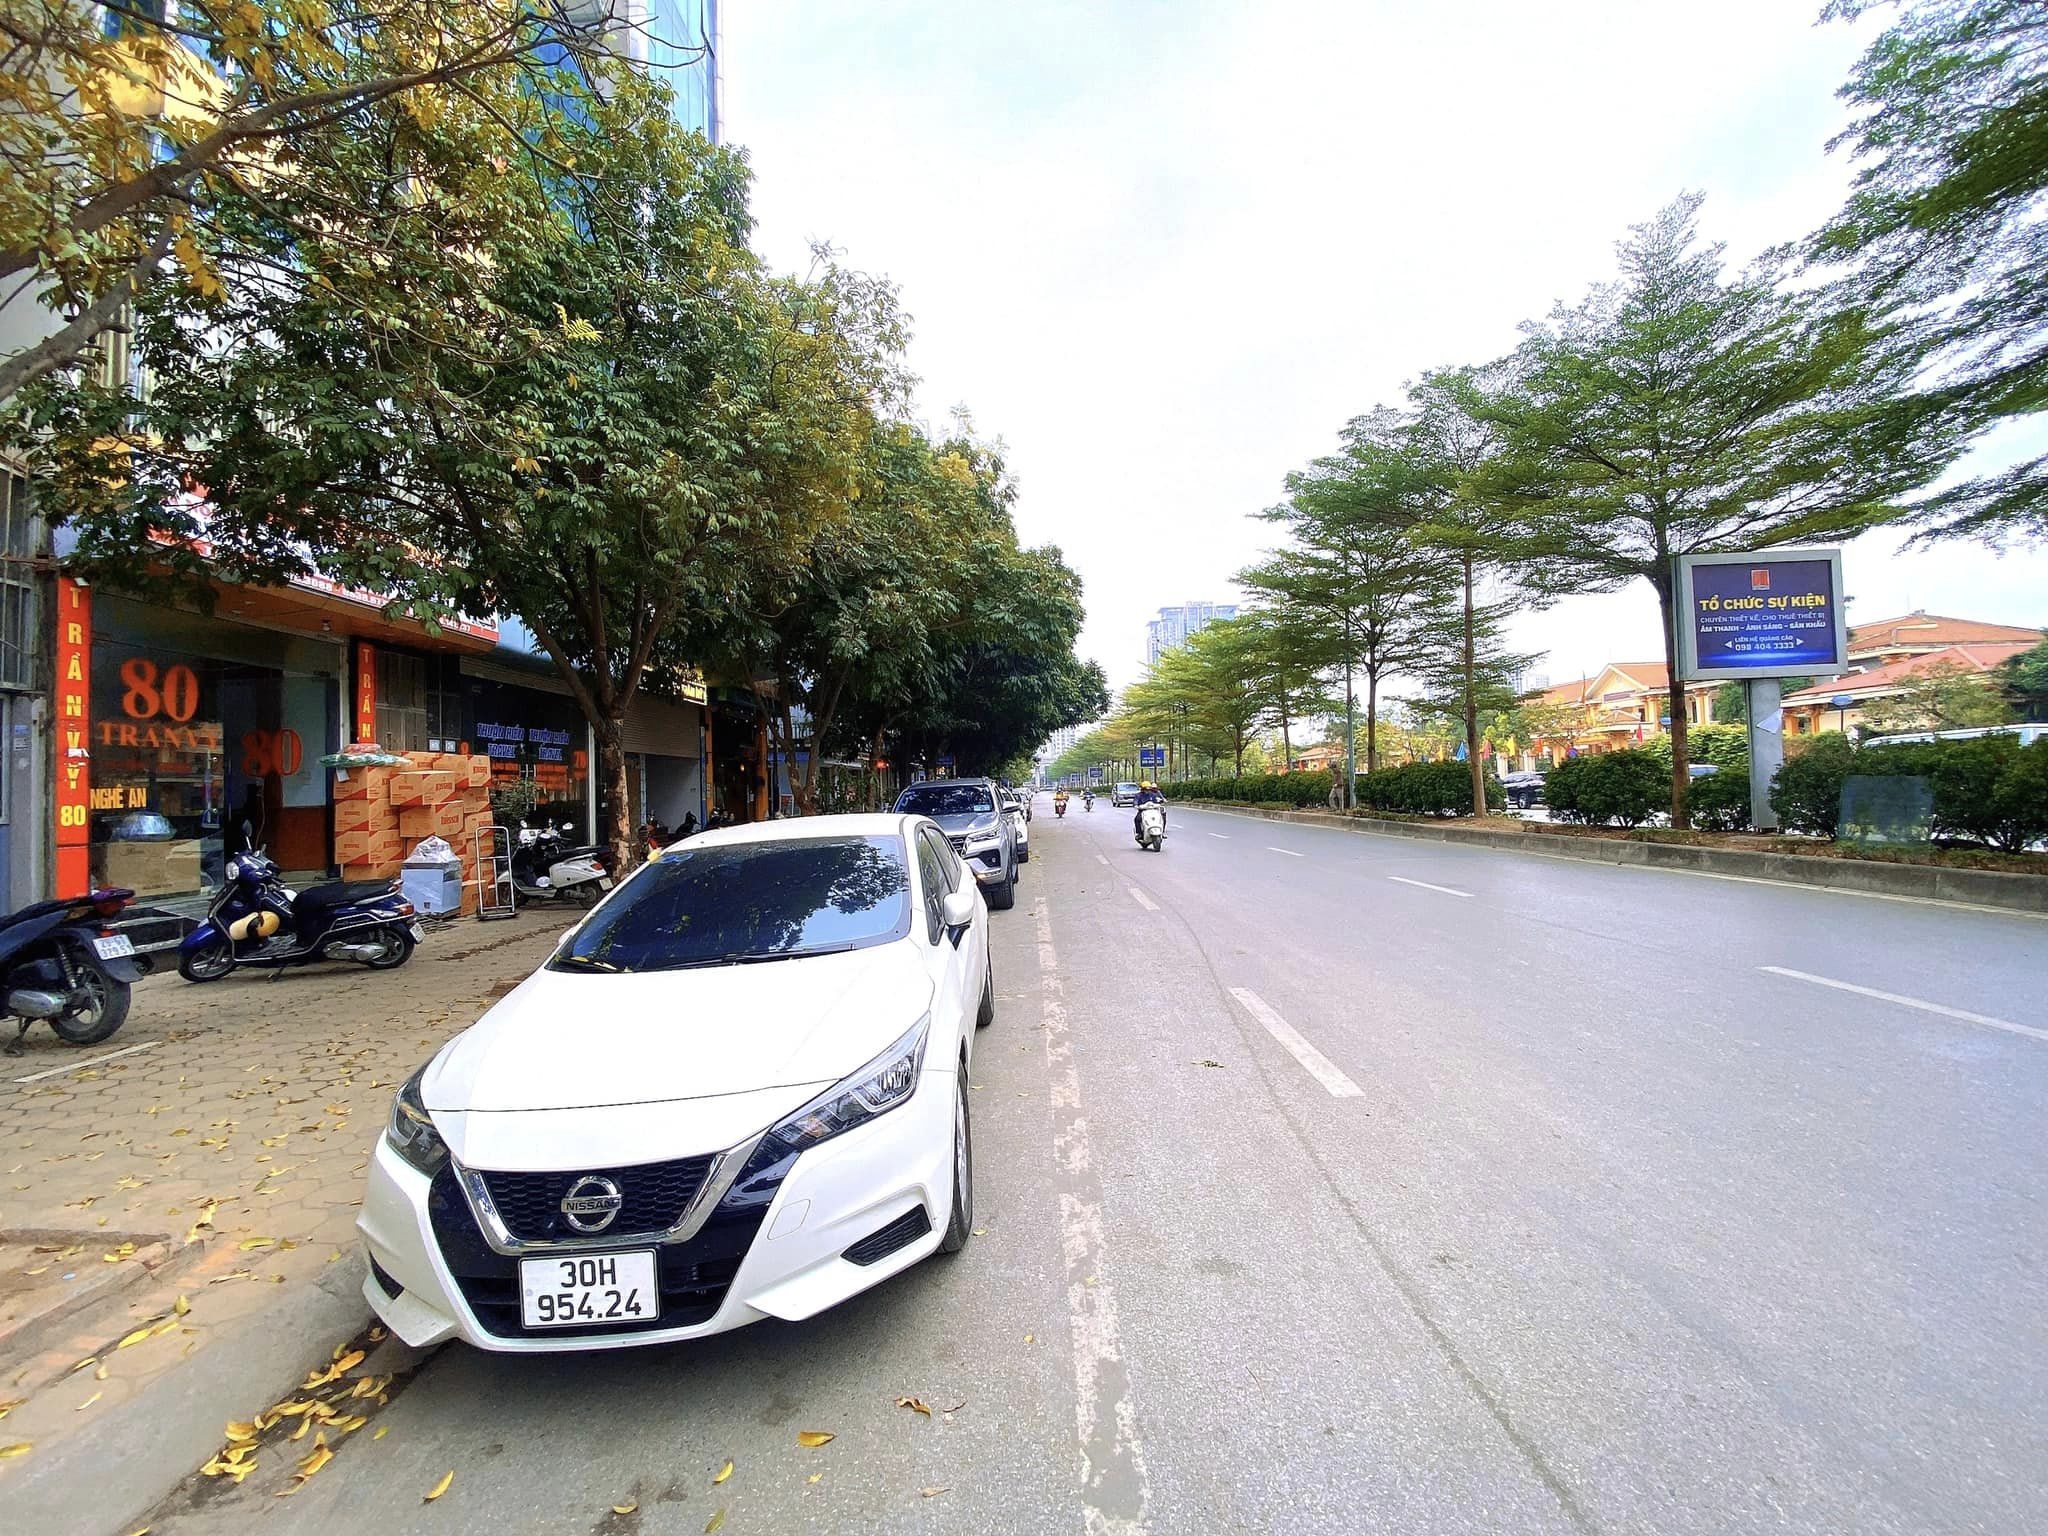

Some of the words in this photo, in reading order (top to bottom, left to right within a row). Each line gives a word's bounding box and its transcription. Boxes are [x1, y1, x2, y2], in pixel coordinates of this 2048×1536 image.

[1699, 594, 1720, 611] TỔ
[1723, 595, 1764, 610] CHỨC
[1767, 595, 1788, 611] SỰ
[1791, 593, 1825, 610] KIỆN
[1761, 614, 1777, 622] CHO
[1714, 625, 1740, 633] THANH
[1754, 642, 1771, 651] 404
[1773, 641, 1795, 650] 3333
[120, 657, 199, 721] 80
[129, 787, 147, 808] AN
[60, 805, 87, 827] 80
[566, 1198, 614, 1211] NISSAN
[559, 1257, 617, 1288] 30H
[537, 1288, 642, 1322] 954.24
